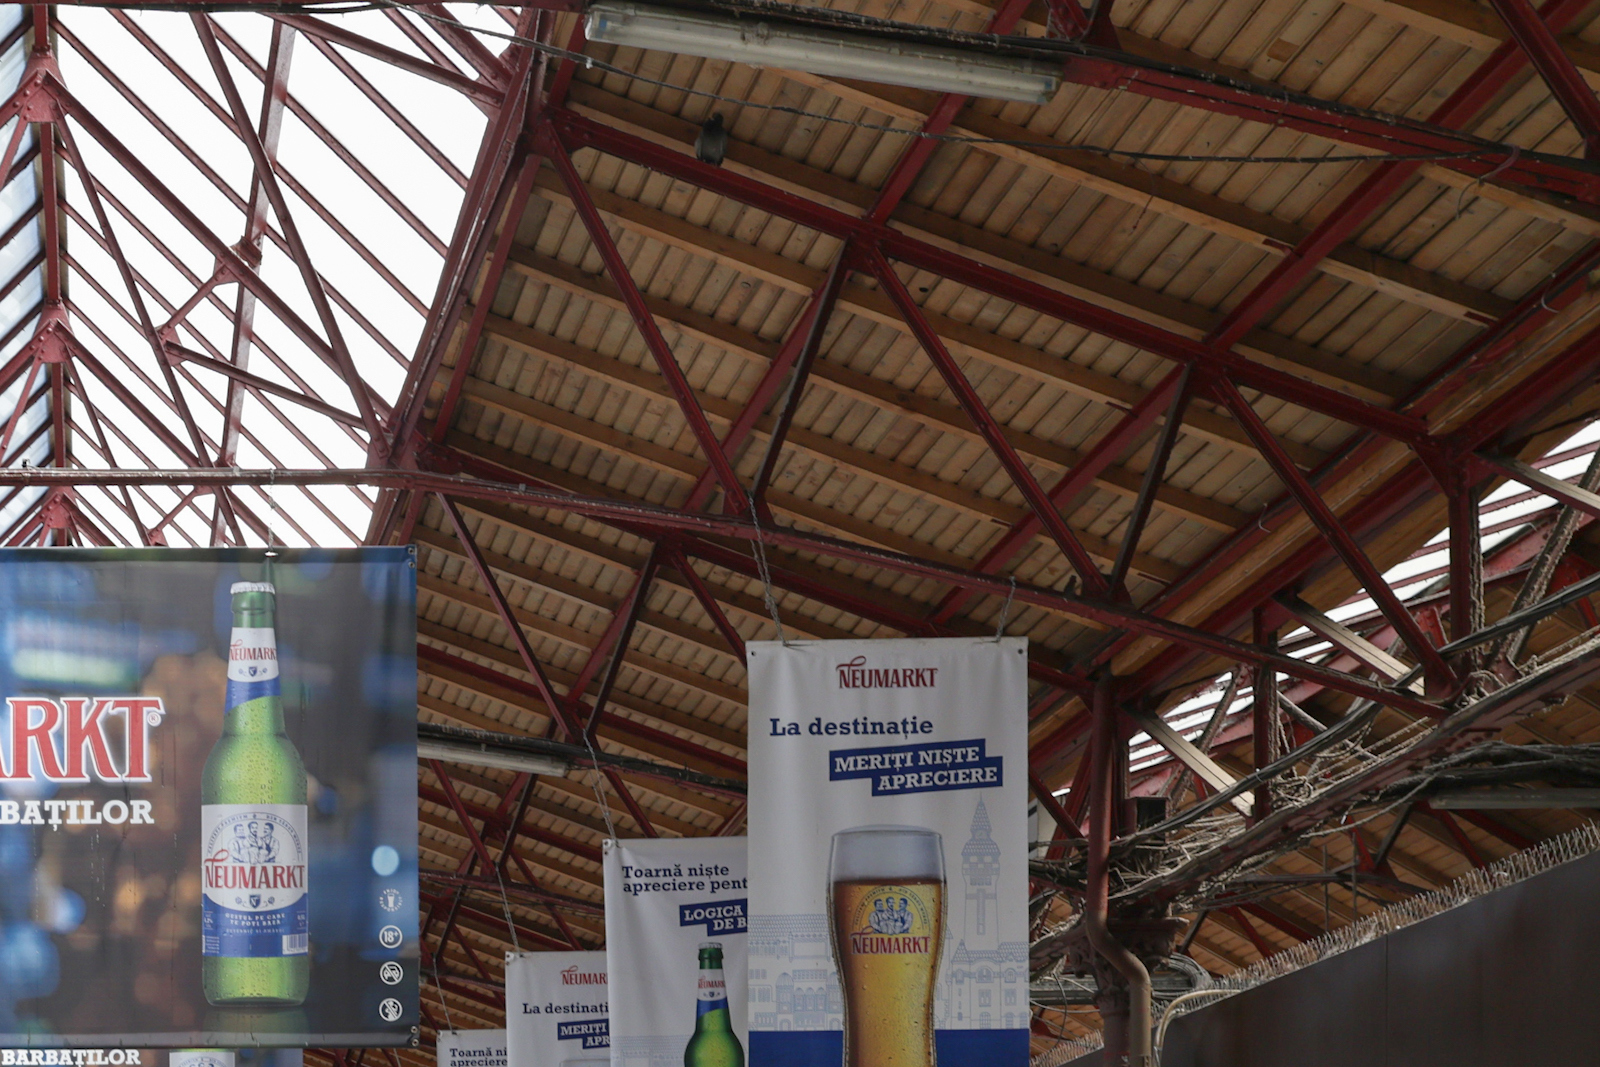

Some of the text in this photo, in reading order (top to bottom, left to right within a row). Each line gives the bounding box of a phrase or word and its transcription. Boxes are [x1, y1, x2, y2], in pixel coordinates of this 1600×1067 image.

[836, 655, 938, 689] NEUMARKT
[770, 716, 934, 740] La destinație
[834, 746, 980, 773] MERIȚI NIȘTE
[878, 766, 998, 791] APRECIERE
[203, 849, 306, 889] NEUMARKT
[622, 864, 729, 879] Toarnă niște
[623, 878, 748, 896] apreciere pent
[684, 905, 743, 921] LOGICA
[713, 919, 733, 931] DE
[383, 930, 399, 943] 18+
[850, 925, 931, 954] NEUMARKT
[560, 965, 608, 985] NEUMAR
[522, 1002, 609, 1016] La destinați
[449, 1047, 492, 1058] Toarnă
